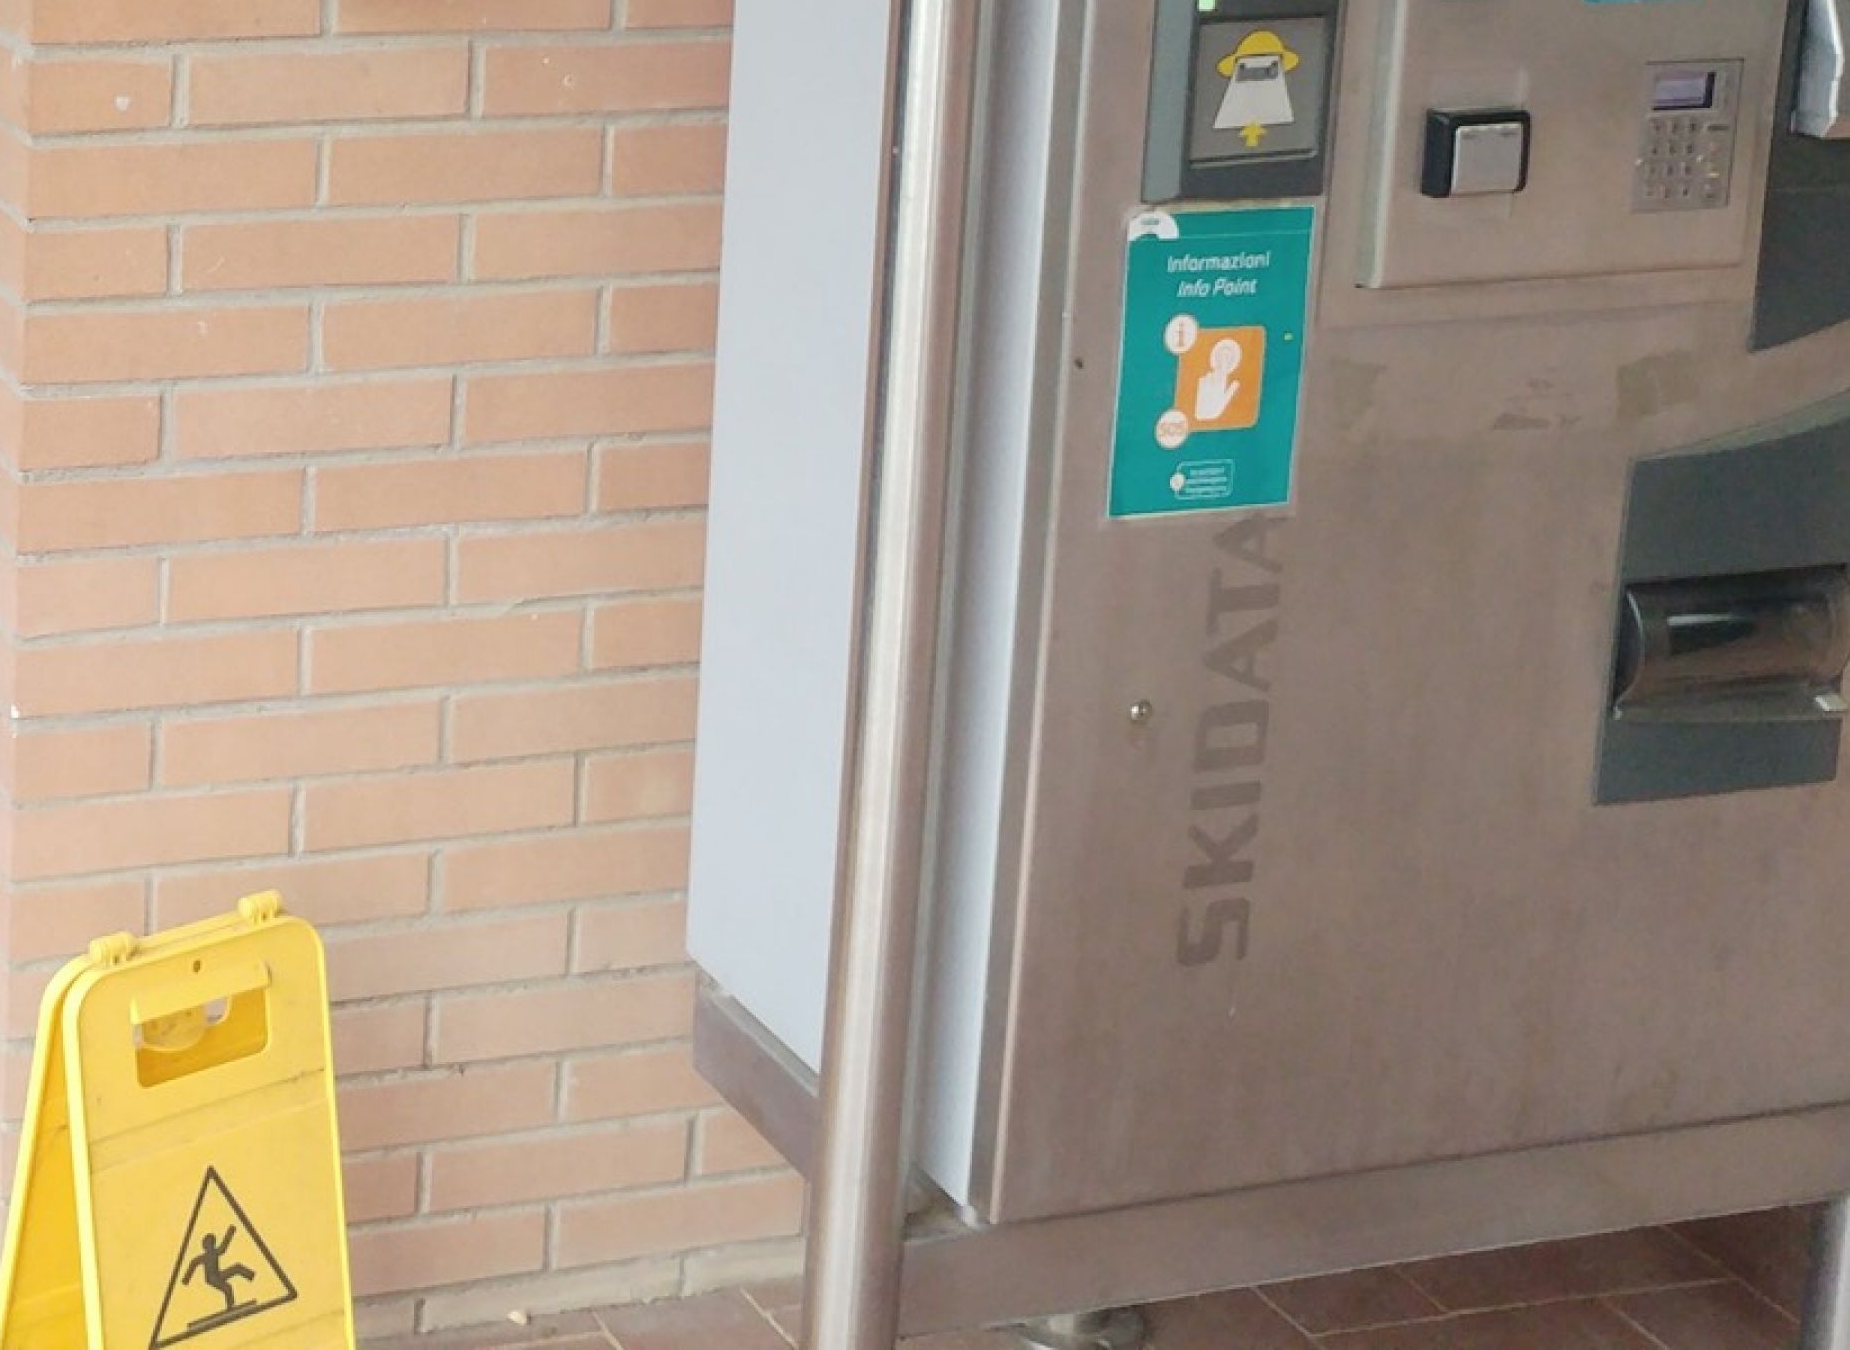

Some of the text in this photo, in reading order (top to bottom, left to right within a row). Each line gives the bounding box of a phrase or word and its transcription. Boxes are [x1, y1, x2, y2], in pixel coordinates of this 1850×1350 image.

[1167, 250, 1271, 273] Informazioni
[1177, 276, 1258, 299] Info Point
[1176, 514, 1292, 969] SKIDATA
